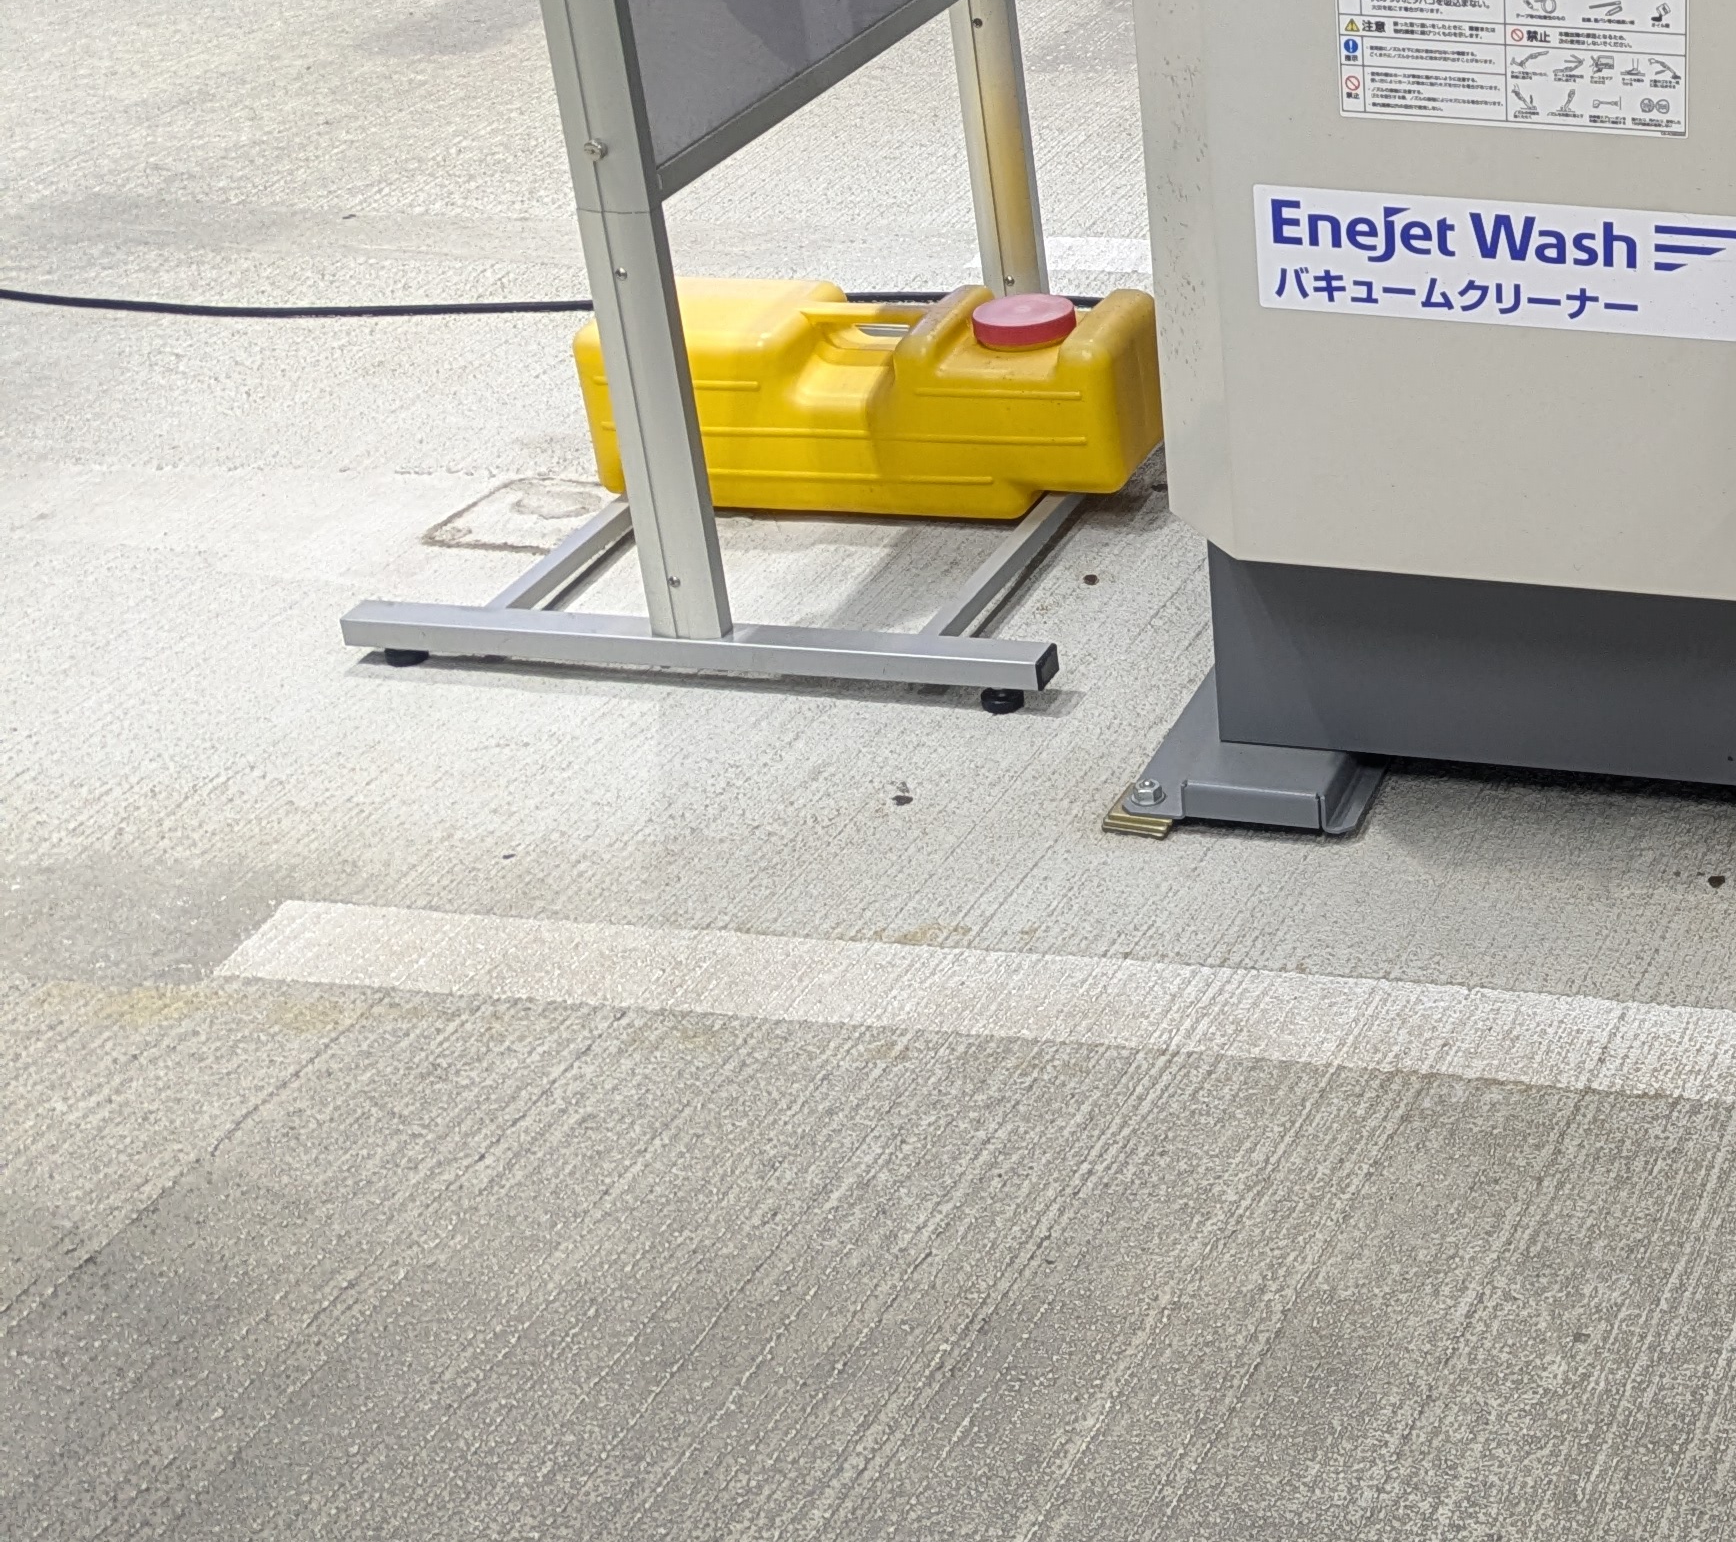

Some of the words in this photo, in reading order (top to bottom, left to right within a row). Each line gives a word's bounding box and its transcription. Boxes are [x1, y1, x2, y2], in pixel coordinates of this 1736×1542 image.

[1362, 20, 1387, 34] 注意
[1526, 29, 1551, 43] 禁止
[1469, 211, 1639, 270] Wash
[1274, 267, 1640, 320] バキュームクリーナー
